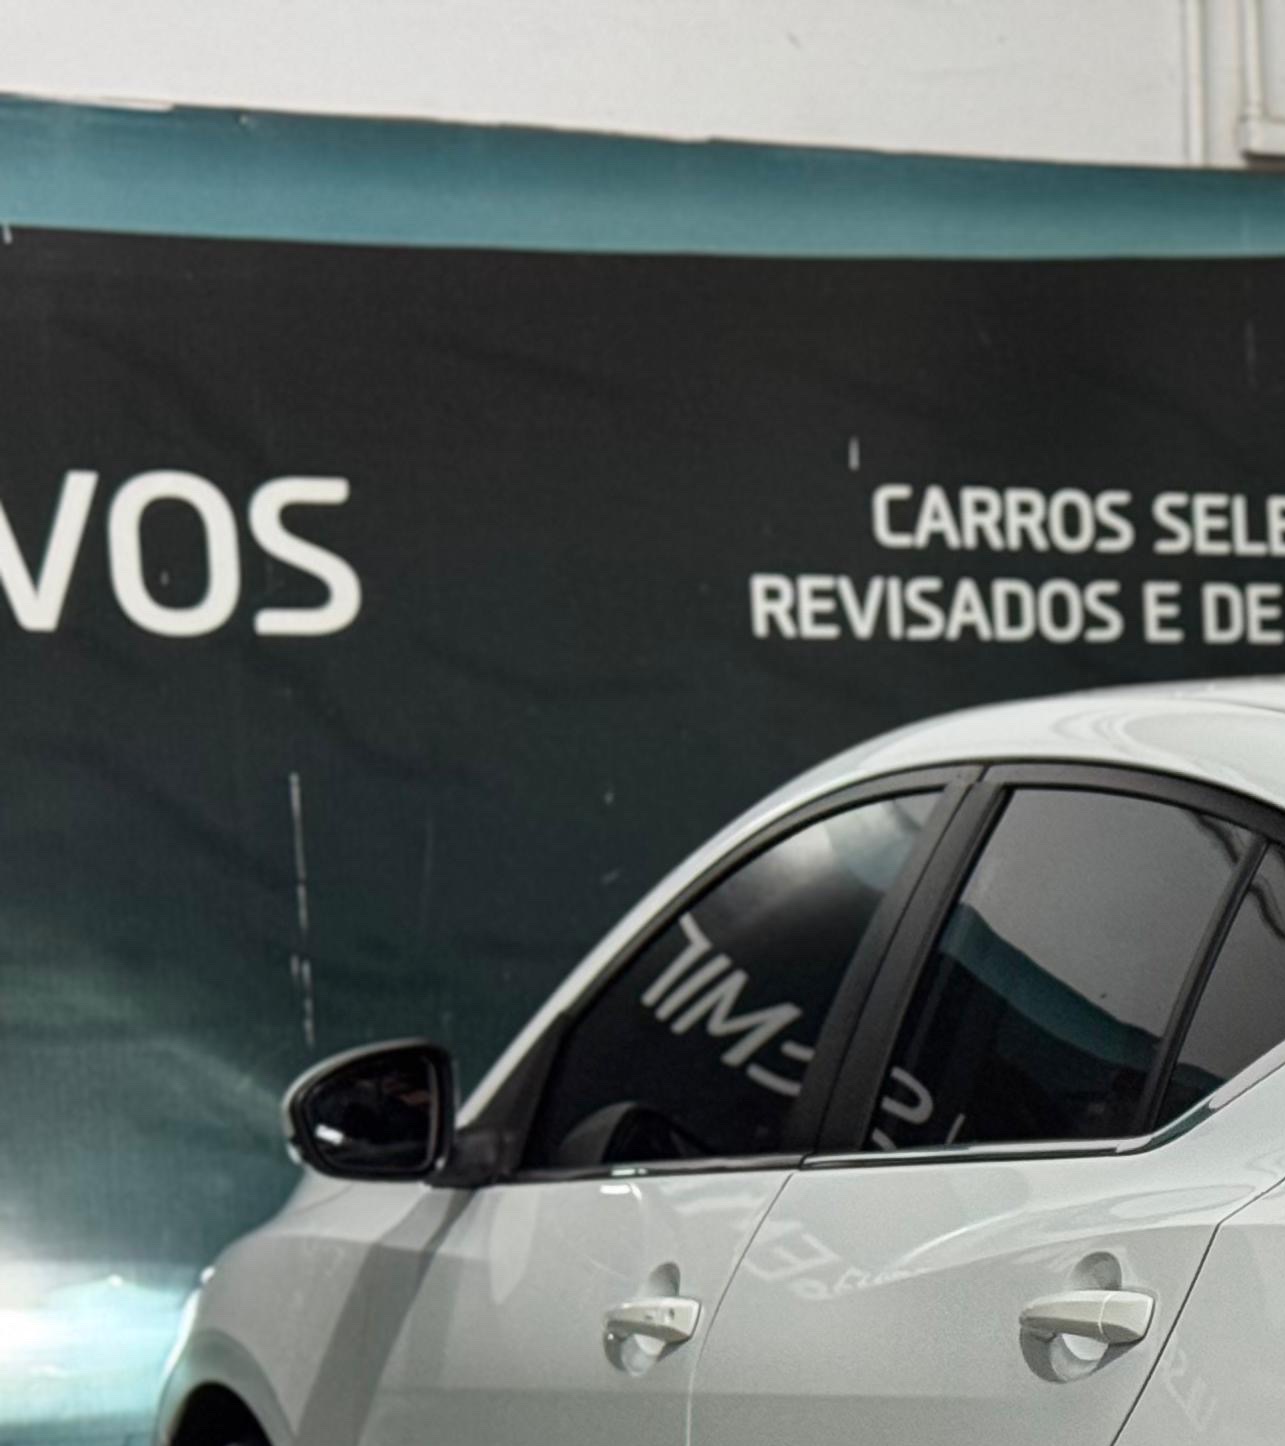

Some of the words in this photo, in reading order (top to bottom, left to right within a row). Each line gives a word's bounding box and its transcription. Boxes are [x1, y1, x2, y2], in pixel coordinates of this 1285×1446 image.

[873, 485, 1133, 553] CARROS
[750, 574, 1122, 642] REVISADOS
[1144, 582, 1182, 643] E
[1203, 583, 1283, 644] DE
